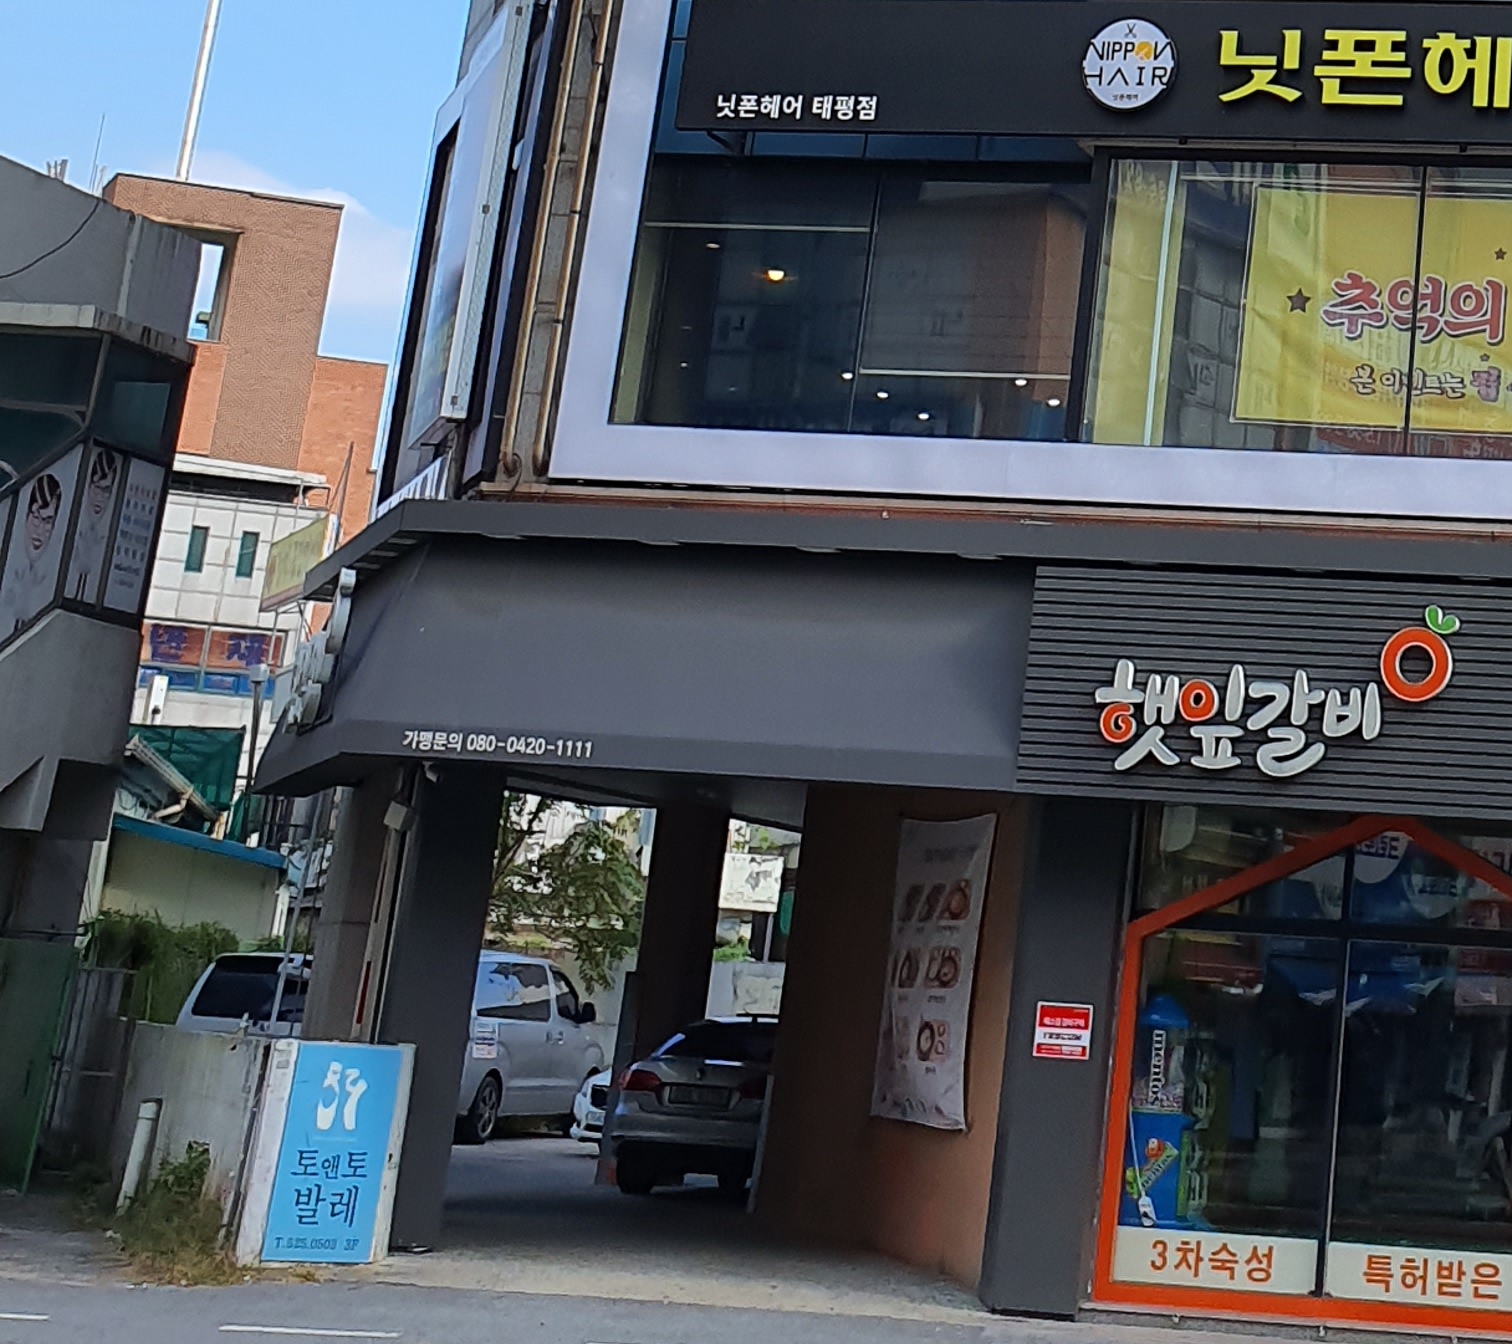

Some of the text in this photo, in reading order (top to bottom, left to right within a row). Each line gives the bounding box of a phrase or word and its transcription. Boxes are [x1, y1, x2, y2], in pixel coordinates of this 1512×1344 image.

[1083, 65, 1173, 87] HAIR
[715, 93, 879, 122] 닛폰헤어 태평점
[1320, 272, 1508, 345] 추억의
[1095, 658, 1382, 778] 햇잎갈비
[402, 729, 594, 759] 가맹문의 080-0420-1111
[1150, 1029, 1167, 1107] mentos
[290, 1149, 369, 1181] 토앤토
[294, 1183, 360, 1229] 발레
[1150, 1239, 1503, 1300] 3차숙성 특허받은
